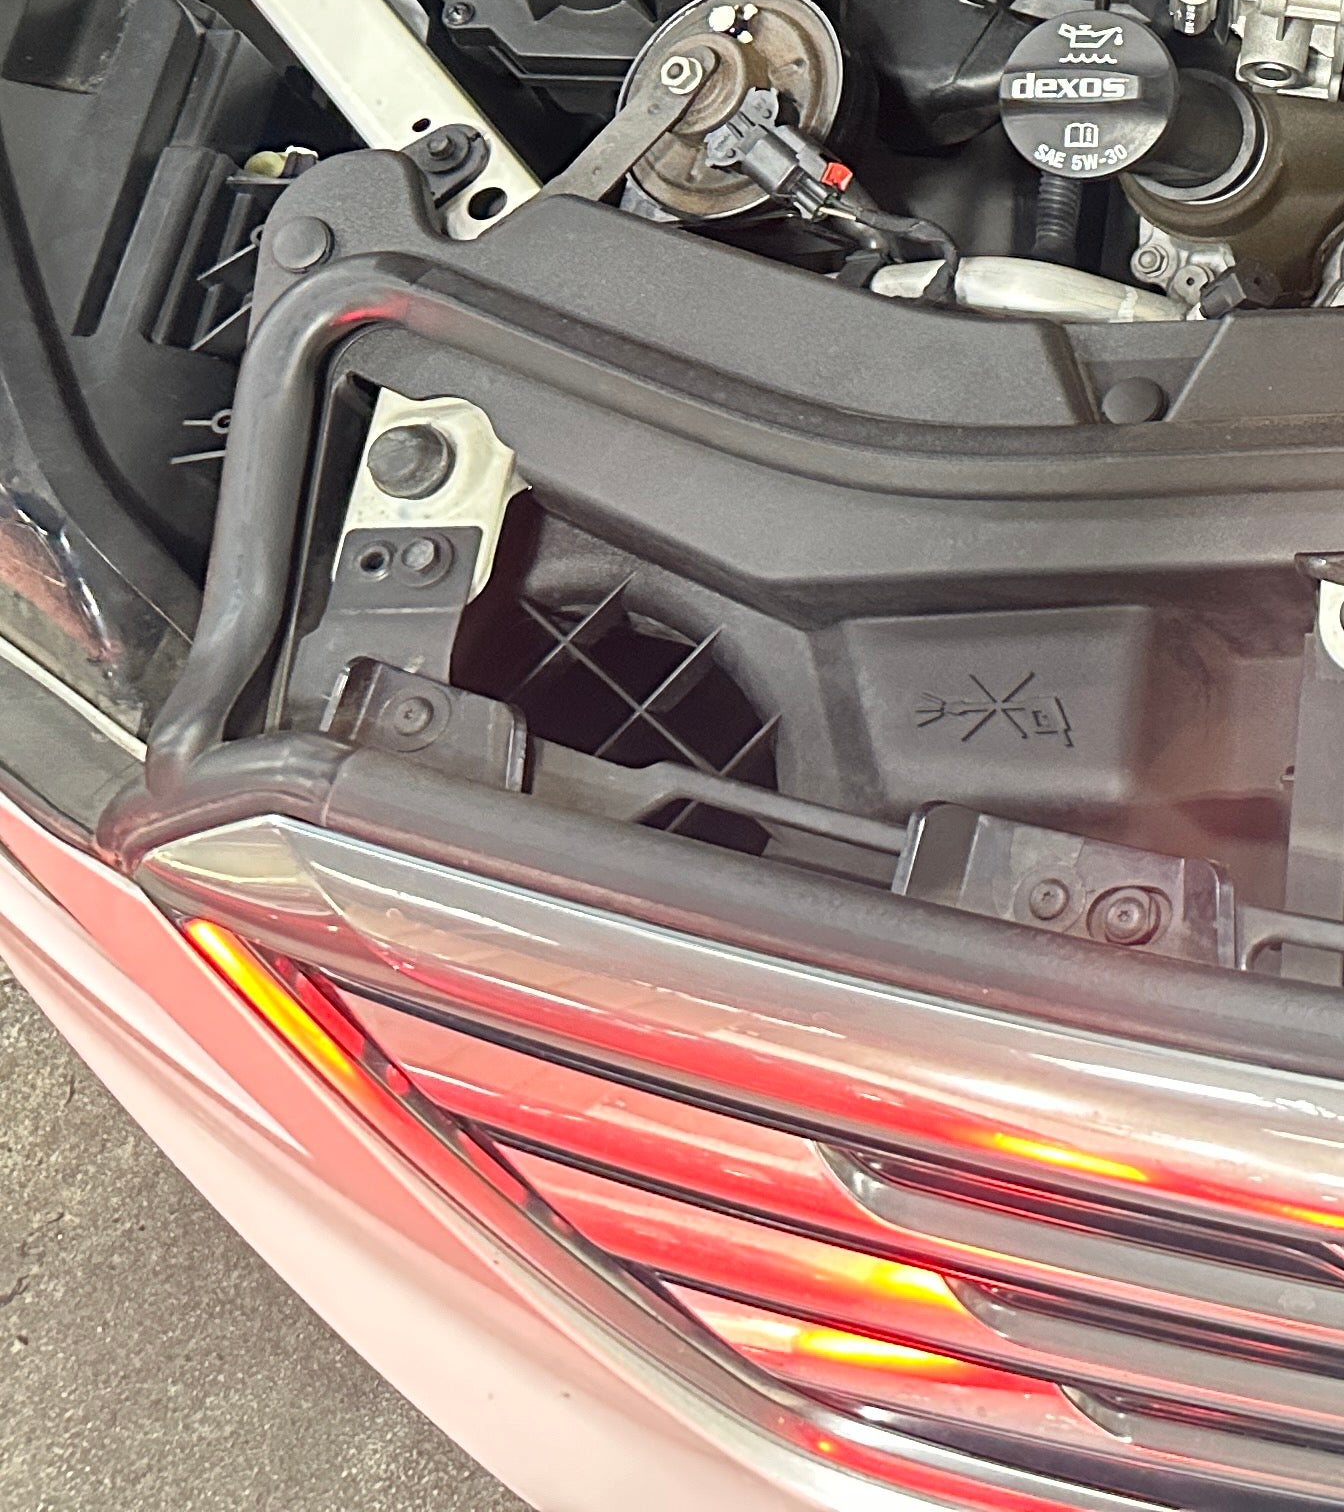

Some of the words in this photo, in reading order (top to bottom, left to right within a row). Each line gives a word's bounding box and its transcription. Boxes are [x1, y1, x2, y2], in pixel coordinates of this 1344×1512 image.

[1010, 72, 1126, 99] dexos
[1033, 143, 1067, 169] SAE
[1071, 144, 1128, 172] 5W-30
